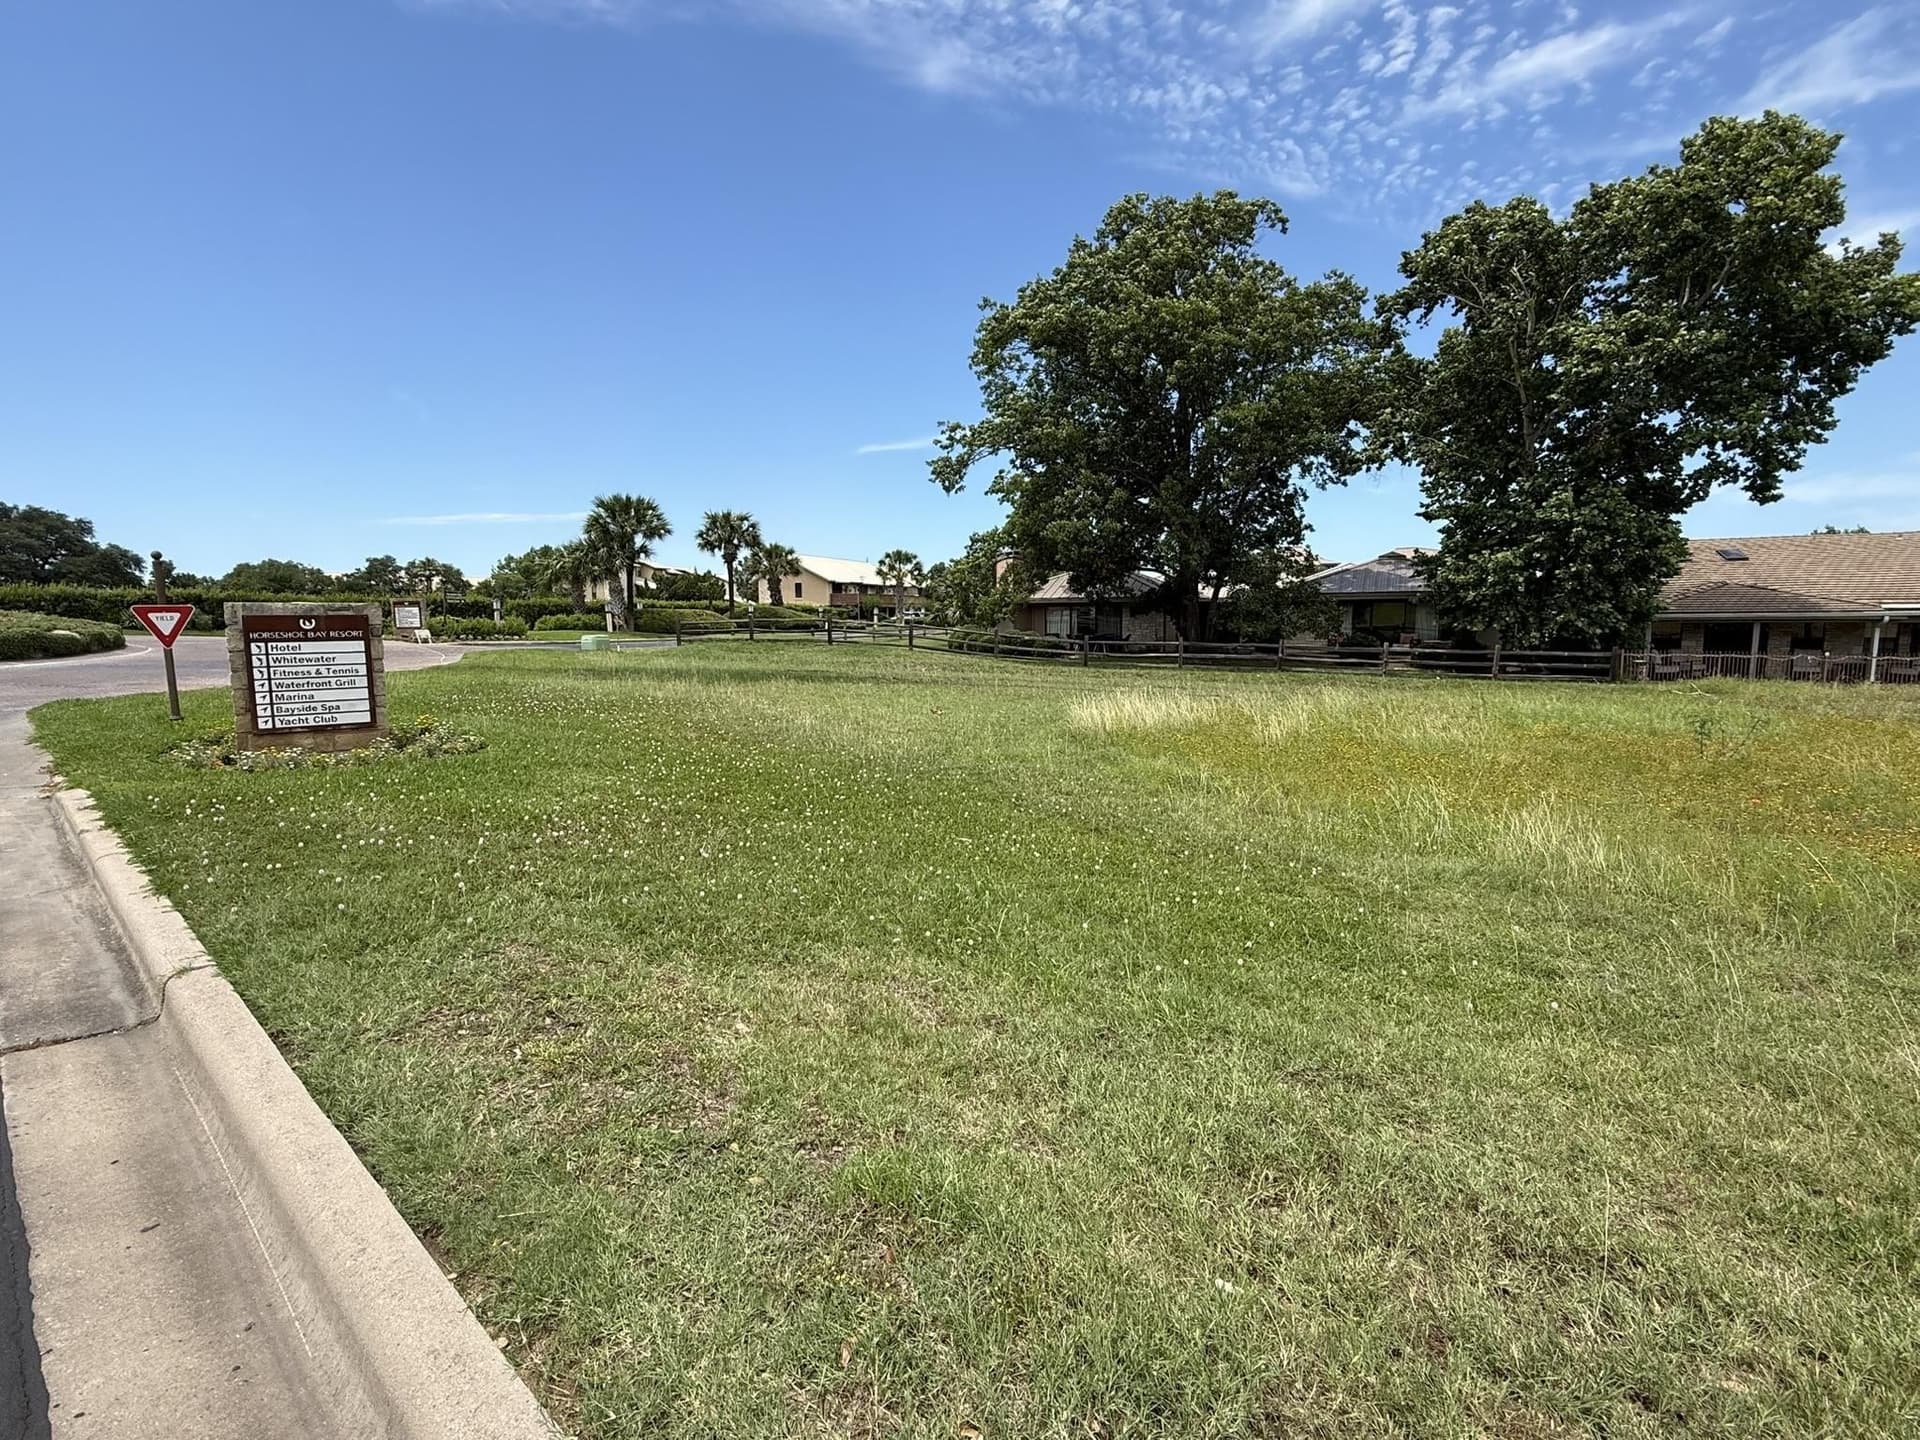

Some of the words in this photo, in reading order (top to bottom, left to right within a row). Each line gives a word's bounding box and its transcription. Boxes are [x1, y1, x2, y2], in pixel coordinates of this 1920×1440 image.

[250, 631, 304, 639] HORSESHOE
[270, 644, 302, 652] Hotel
[272, 655, 336, 664] Whitewater
[272, 668, 312, 677] Fitness
[326, 667, 360, 675] Tennis
[274, 680, 333, 689] Waterfront
[334, 679, 356, 687] Grill
[274, 693, 314, 702] Marina
[276, 705, 318, 716] Bayside
[321, 704, 341, 712] Spa
[278, 716, 309, 726] Yacht
[313, 715, 338, 723] Club
